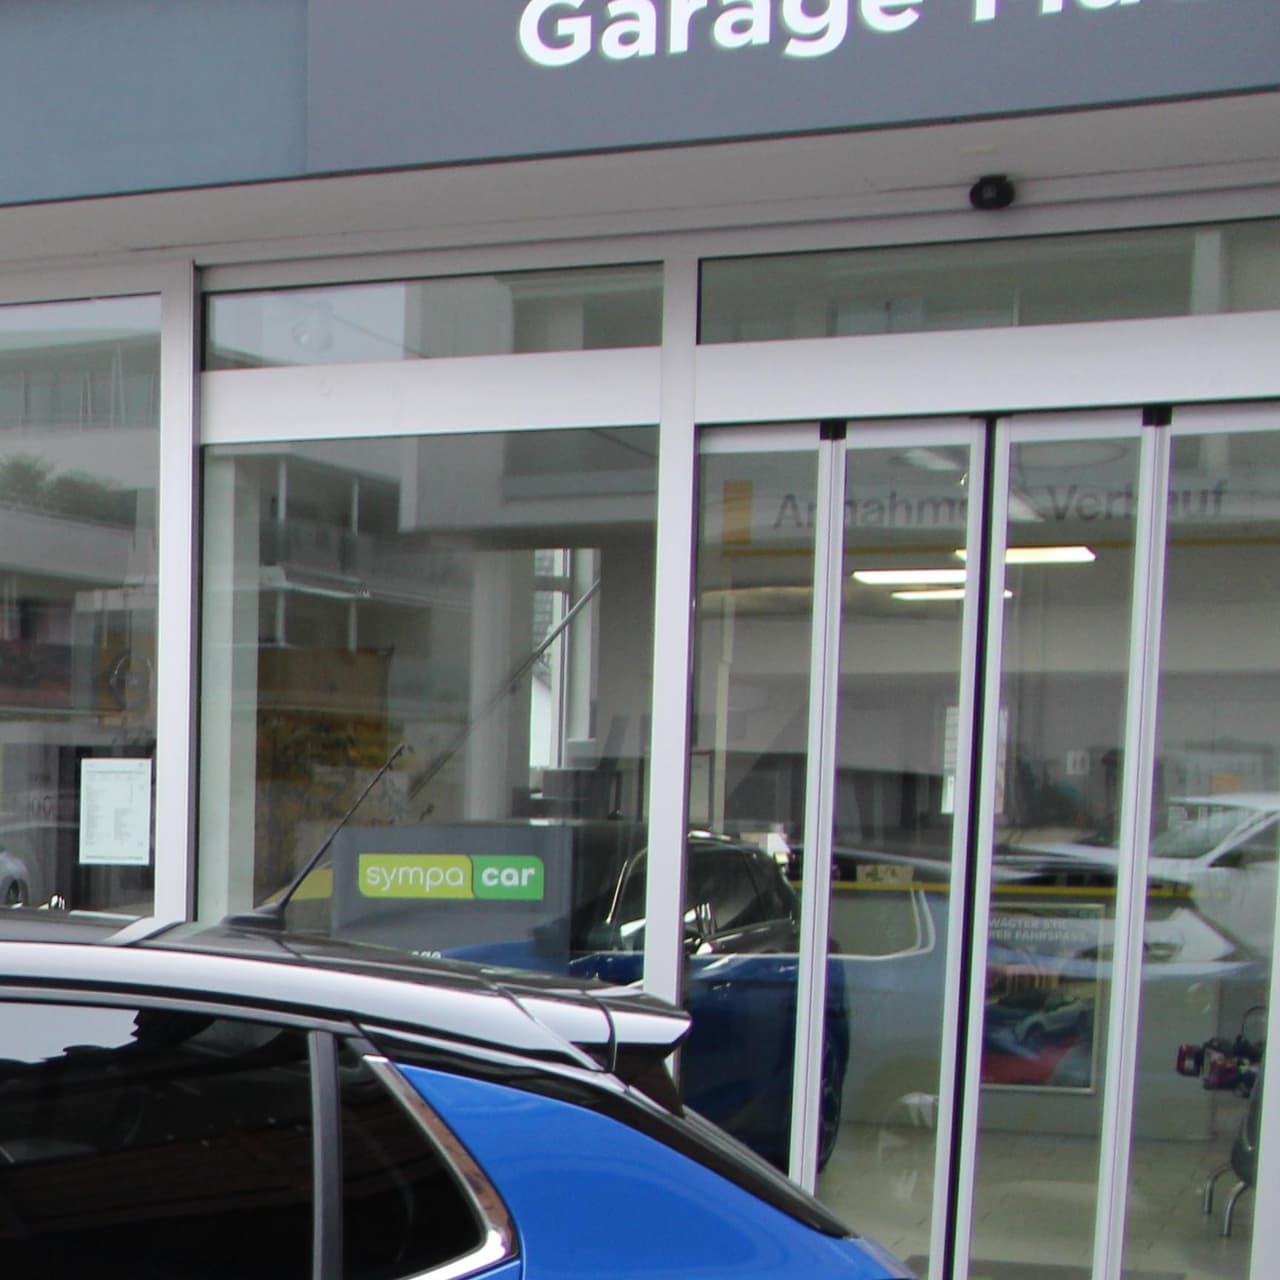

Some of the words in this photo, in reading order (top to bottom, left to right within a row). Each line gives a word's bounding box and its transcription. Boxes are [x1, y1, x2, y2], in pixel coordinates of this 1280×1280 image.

[517, 0, 922, 66] Garage
[365, 865, 465, 892] sympa
[481, 866, 536, 887] car
